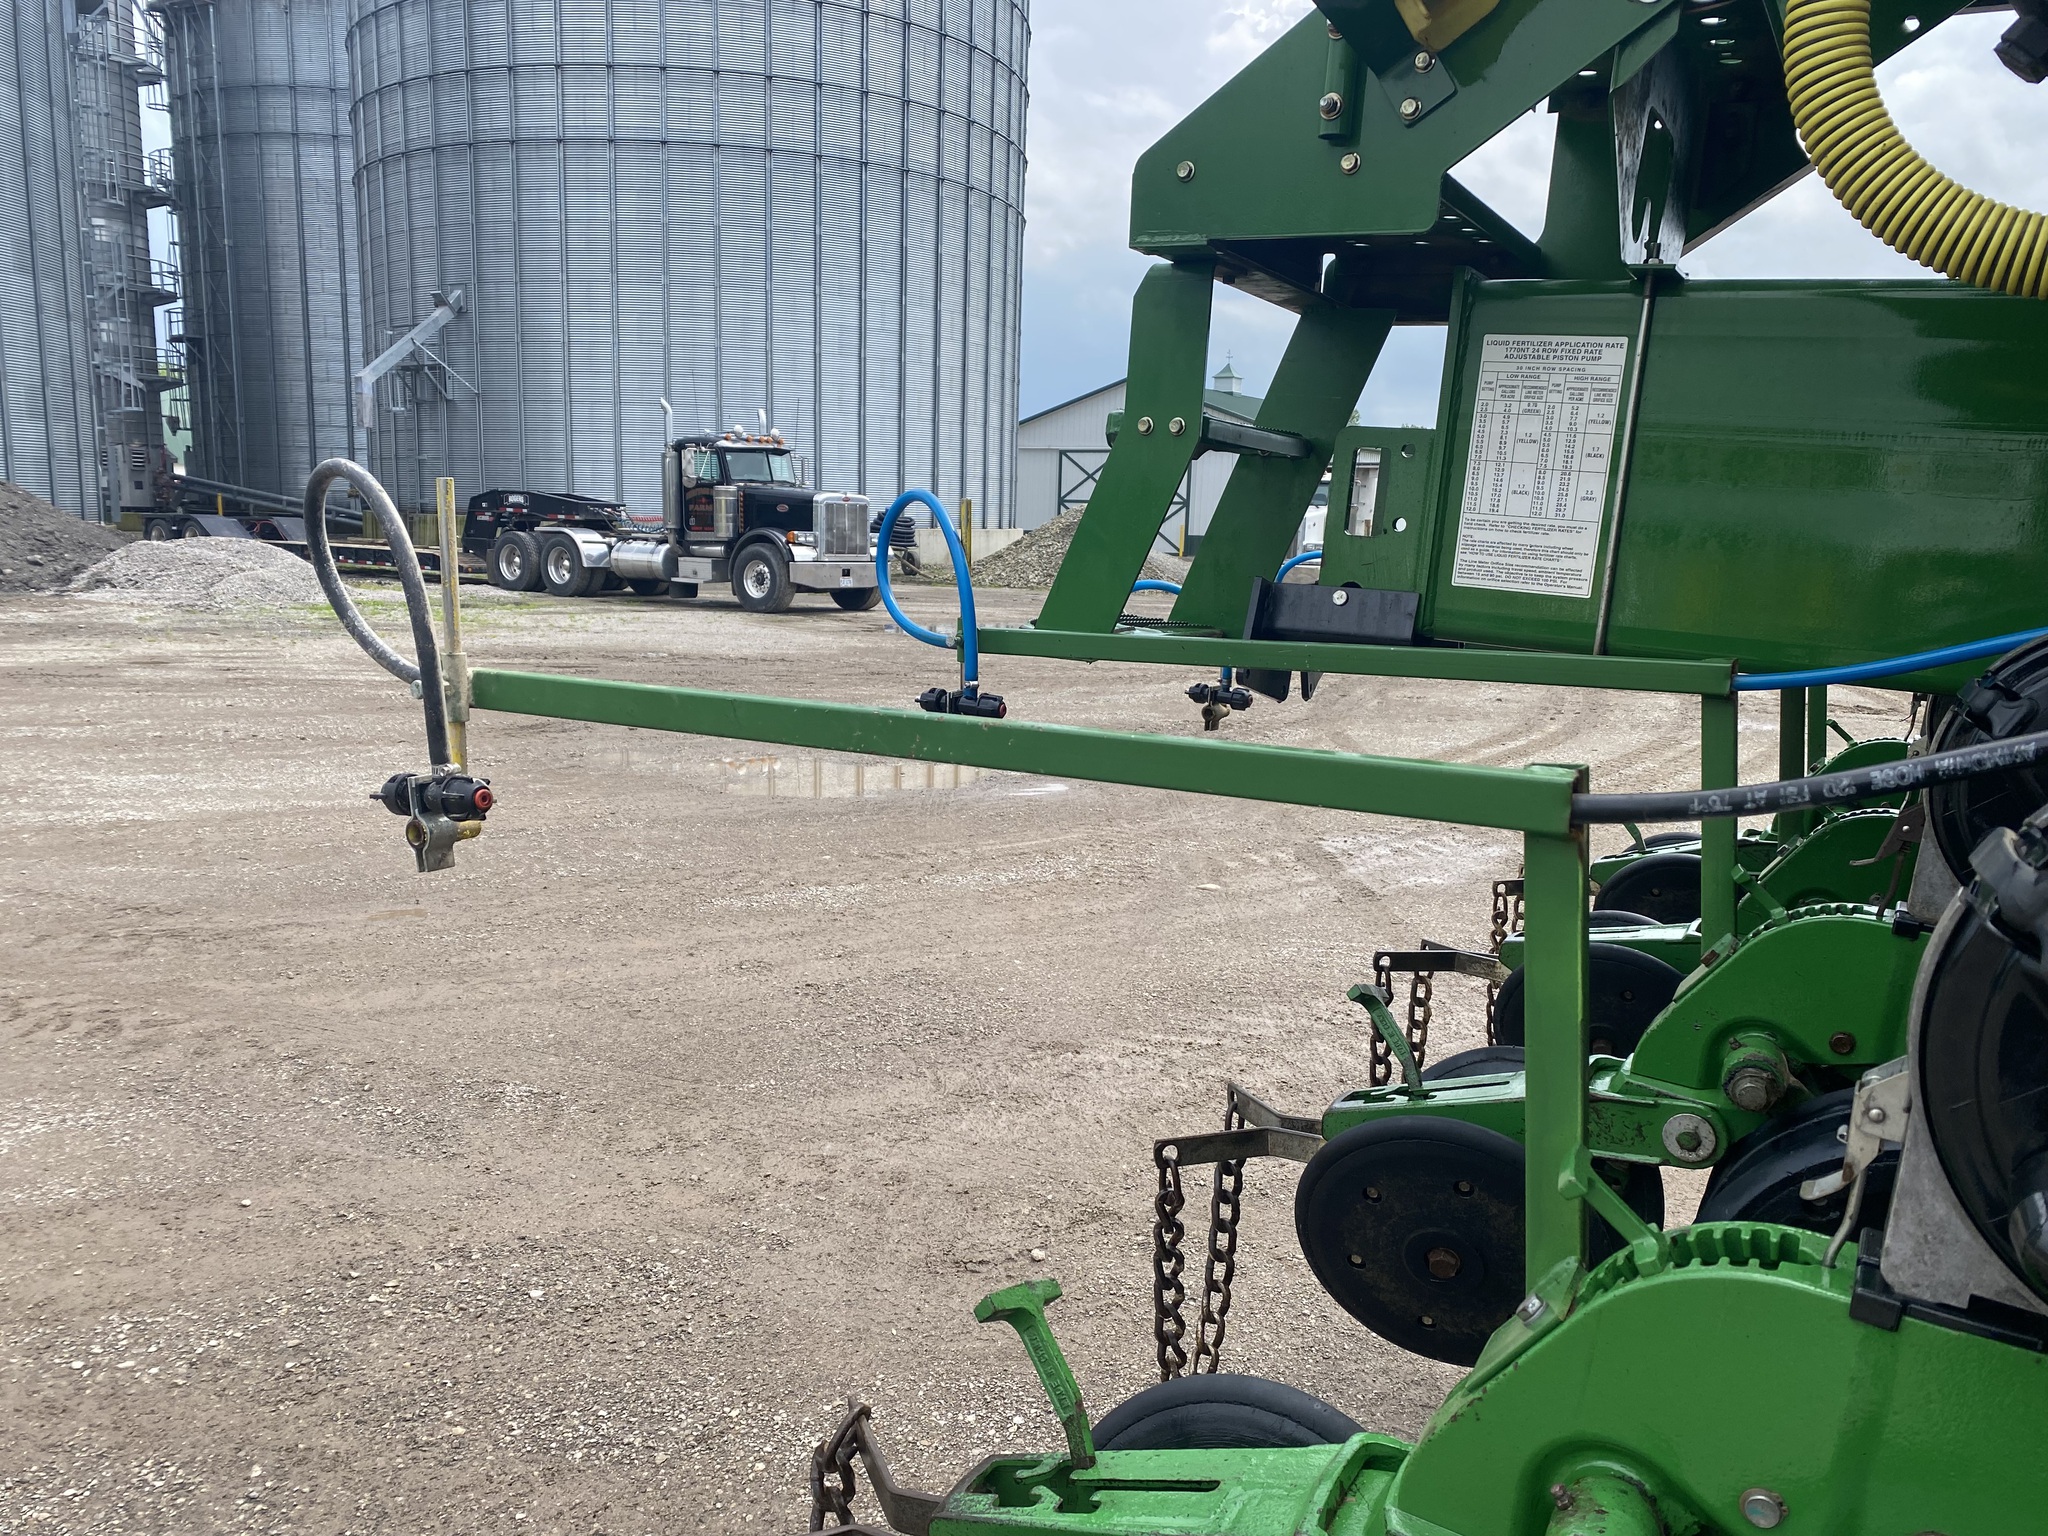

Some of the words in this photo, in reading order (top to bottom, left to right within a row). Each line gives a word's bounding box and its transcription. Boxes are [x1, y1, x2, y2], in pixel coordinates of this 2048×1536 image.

[508, 494, 524, 503] ROGERS
[1934, 741, 2037, 779] AMMONIA
[1869, 764, 1924, 790] HOSE
[1744, 790, 1768, 810] AT
[1779, 784, 1811, 805] PSI
[1050, 1381, 1070, 1410] MADE
